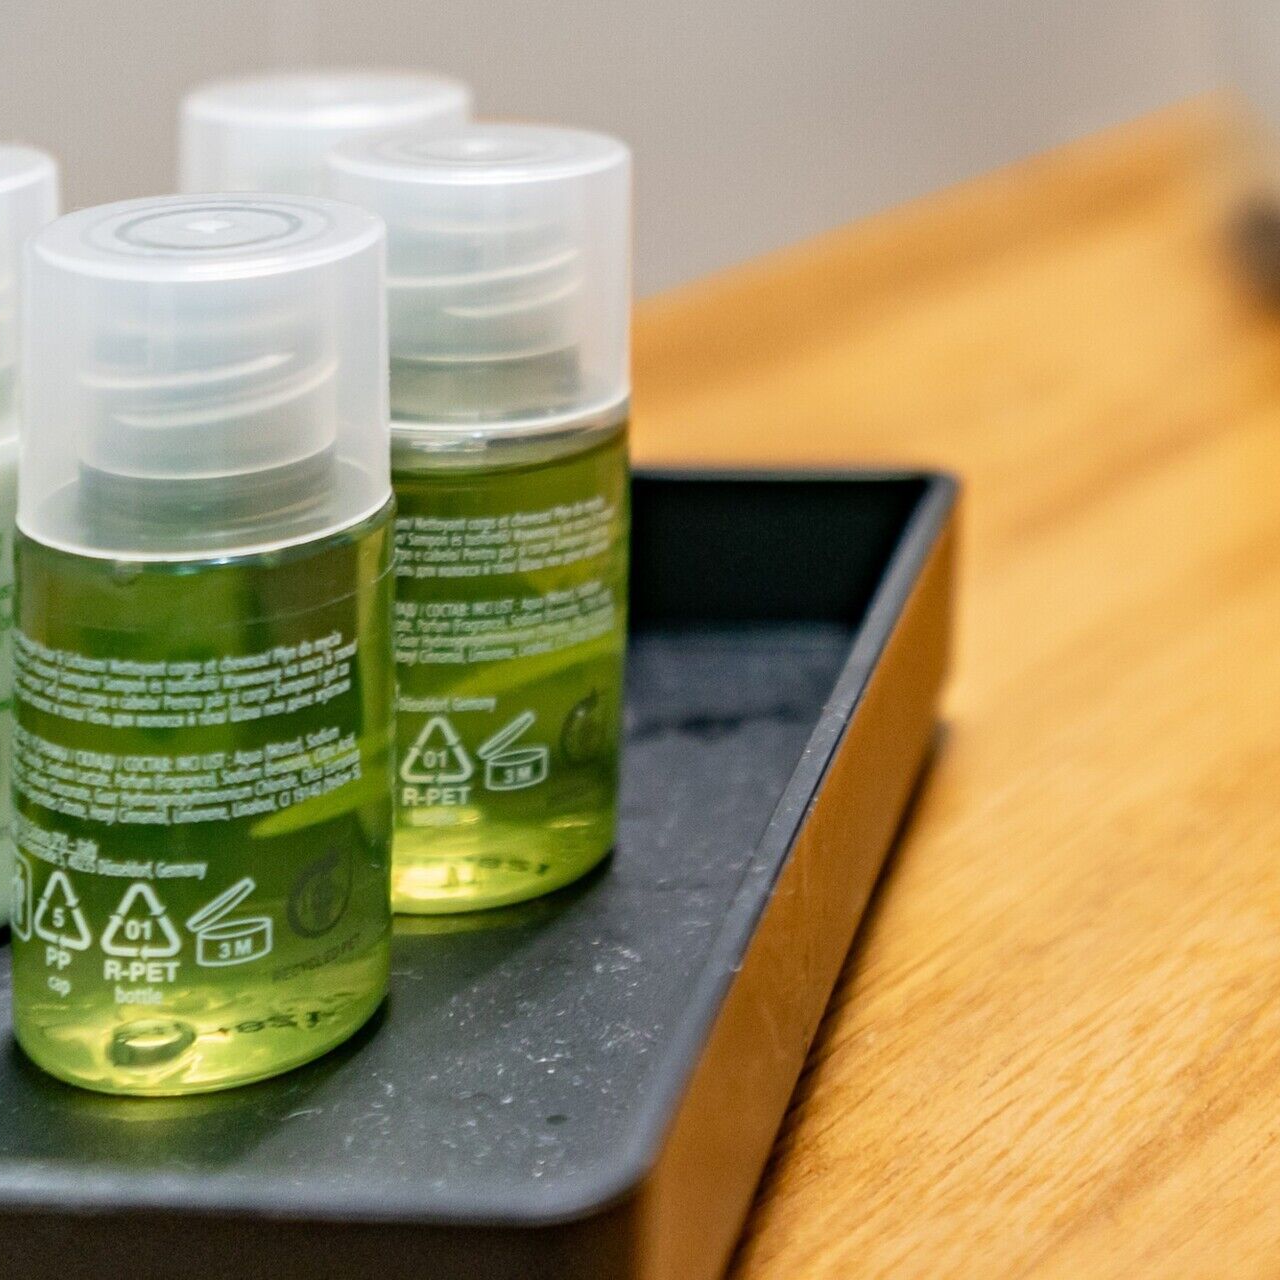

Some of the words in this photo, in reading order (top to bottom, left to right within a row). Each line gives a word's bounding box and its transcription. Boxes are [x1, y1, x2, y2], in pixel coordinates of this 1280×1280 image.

[423, 751, 448, 768] 01
[402, 787, 470, 807] R-PET
[52, 907, 65, 928] 5
[124, 919, 153, 941] 01
[45, 946, 71, 970] PP
[234, 938, 252, 960] M
[103, 960, 181, 984] R-PET
[114, 986, 163, 1005] bottle
